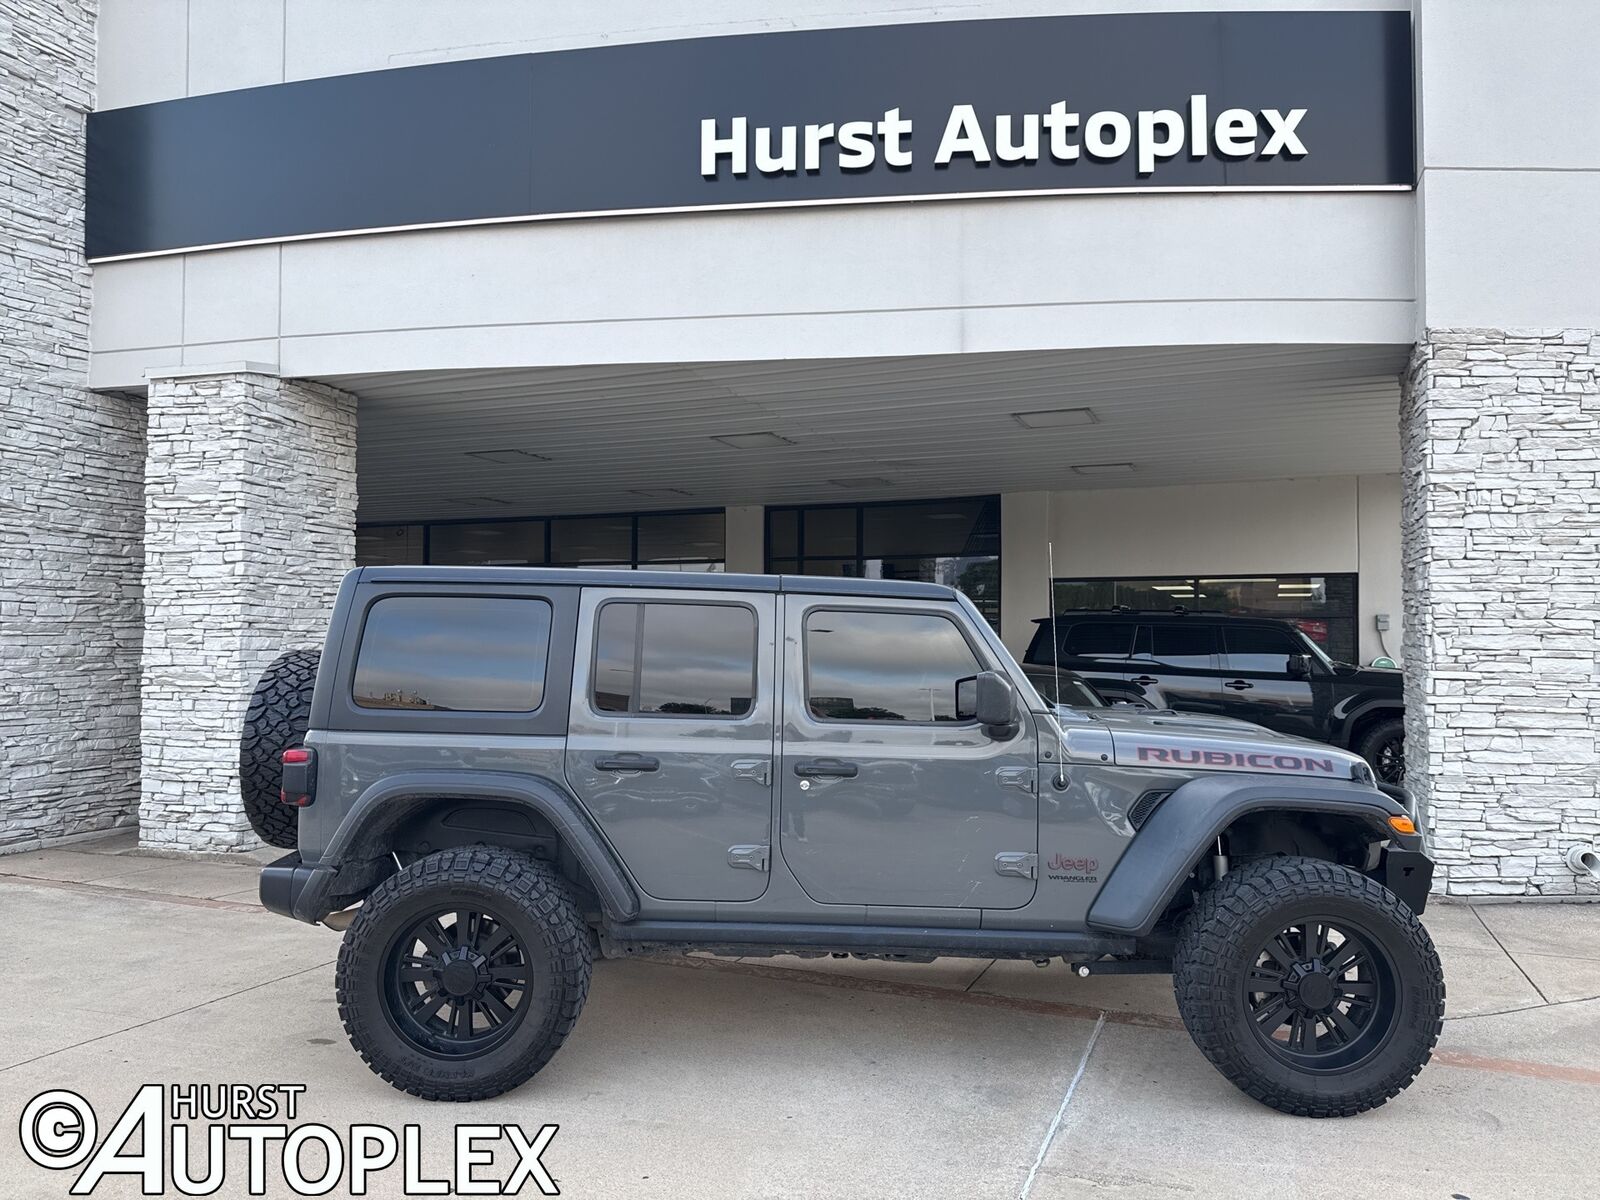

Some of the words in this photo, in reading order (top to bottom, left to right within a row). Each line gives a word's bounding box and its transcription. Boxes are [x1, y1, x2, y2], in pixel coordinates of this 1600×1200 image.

[701, 107, 913, 175] Hurst
[934, 94, 1309, 175] Autoplex
[1136, 746, 1334, 773] RUBICON
[1047, 852, 1099, 874] Jeep
